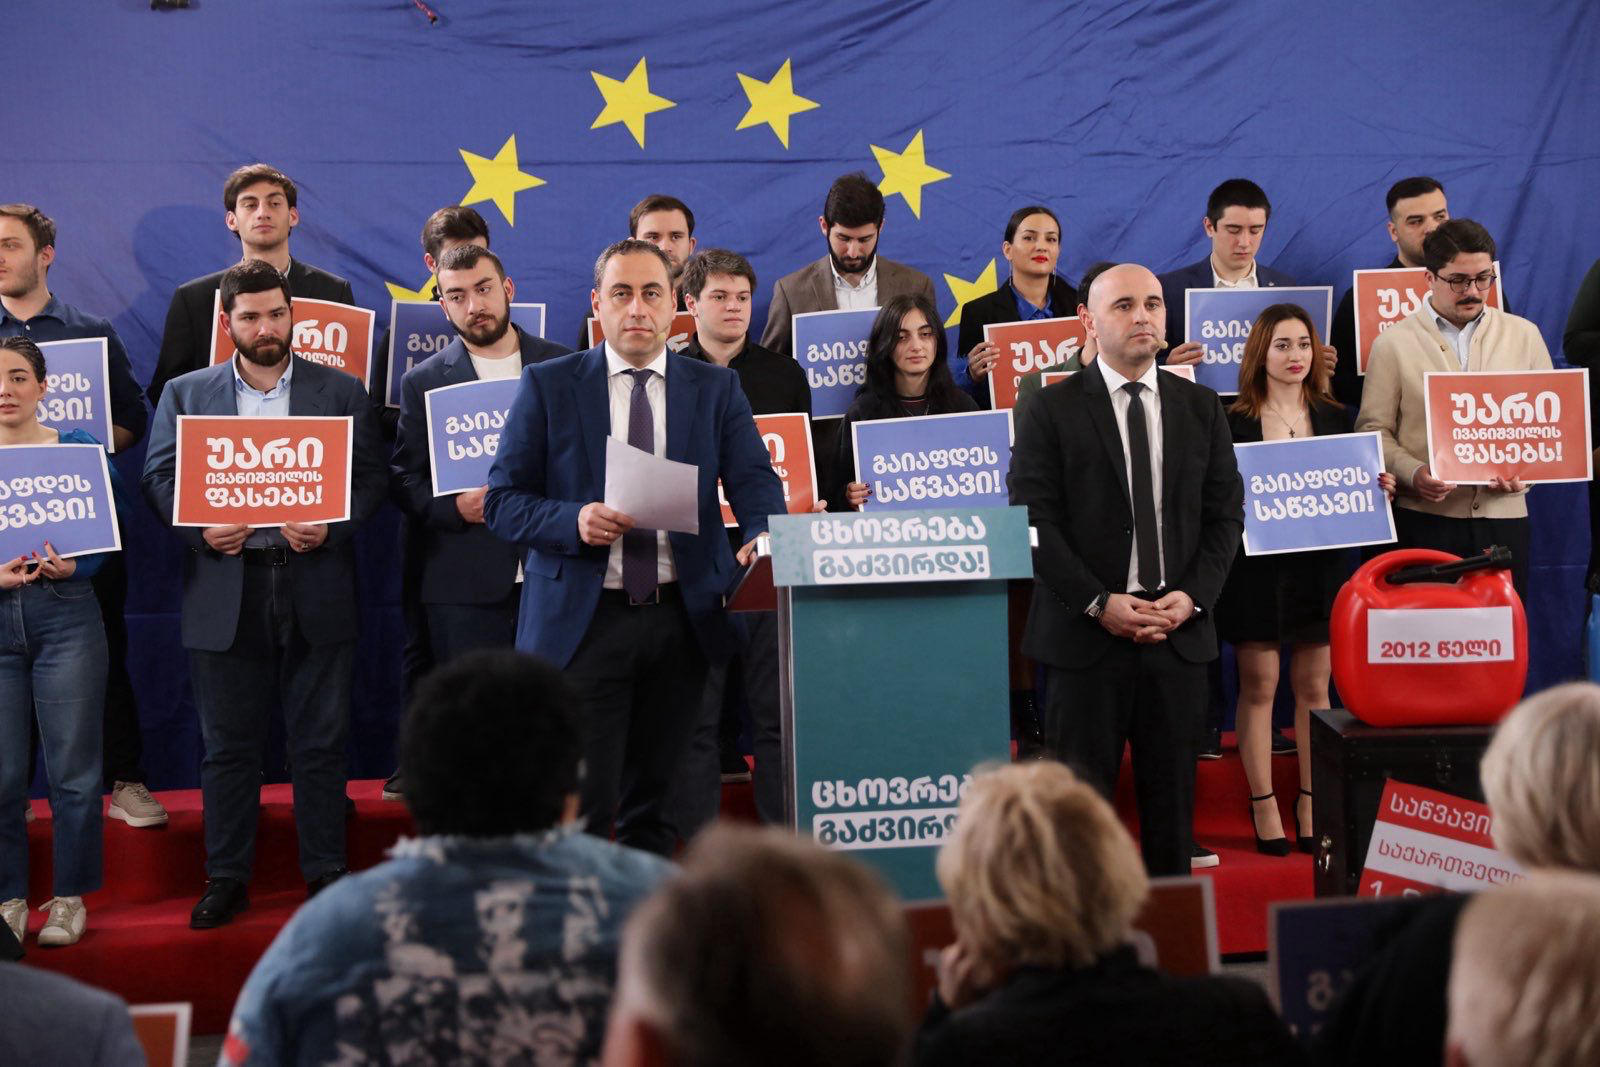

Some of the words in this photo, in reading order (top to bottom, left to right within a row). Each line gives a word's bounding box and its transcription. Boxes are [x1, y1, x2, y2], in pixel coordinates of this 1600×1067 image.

[1010, 336, 1080, 373] უარ
[1450, 391, 1561, 425] უარი
[1452, 426, 1562, 440] ივანიშვილის
[206, 437, 324, 470] უარი
[872, 446, 998, 475] გაიაფდეს
[1453, 441, 1563, 464] ფასებს!
[205, 470, 323, 485] ივანიშვილის
[874, 470, 1001, 503] საწვავი!
[1250, 467, 1371, 495] გაიაფდეს
[204, 485, 323, 508] ფასებს!
[1253, 489, 1375, 521] საწვავი!
[810, 515, 987, 545] ცხოვრება
[819, 551, 985, 578] გაძვირდა!
[1380, 641, 1431, 658] 2012
[1437, 639, 1502, 658] წელი
[812, 774, 974, 809] ცხოვრებ
[818, 814, 958, 845] გაძვირ
